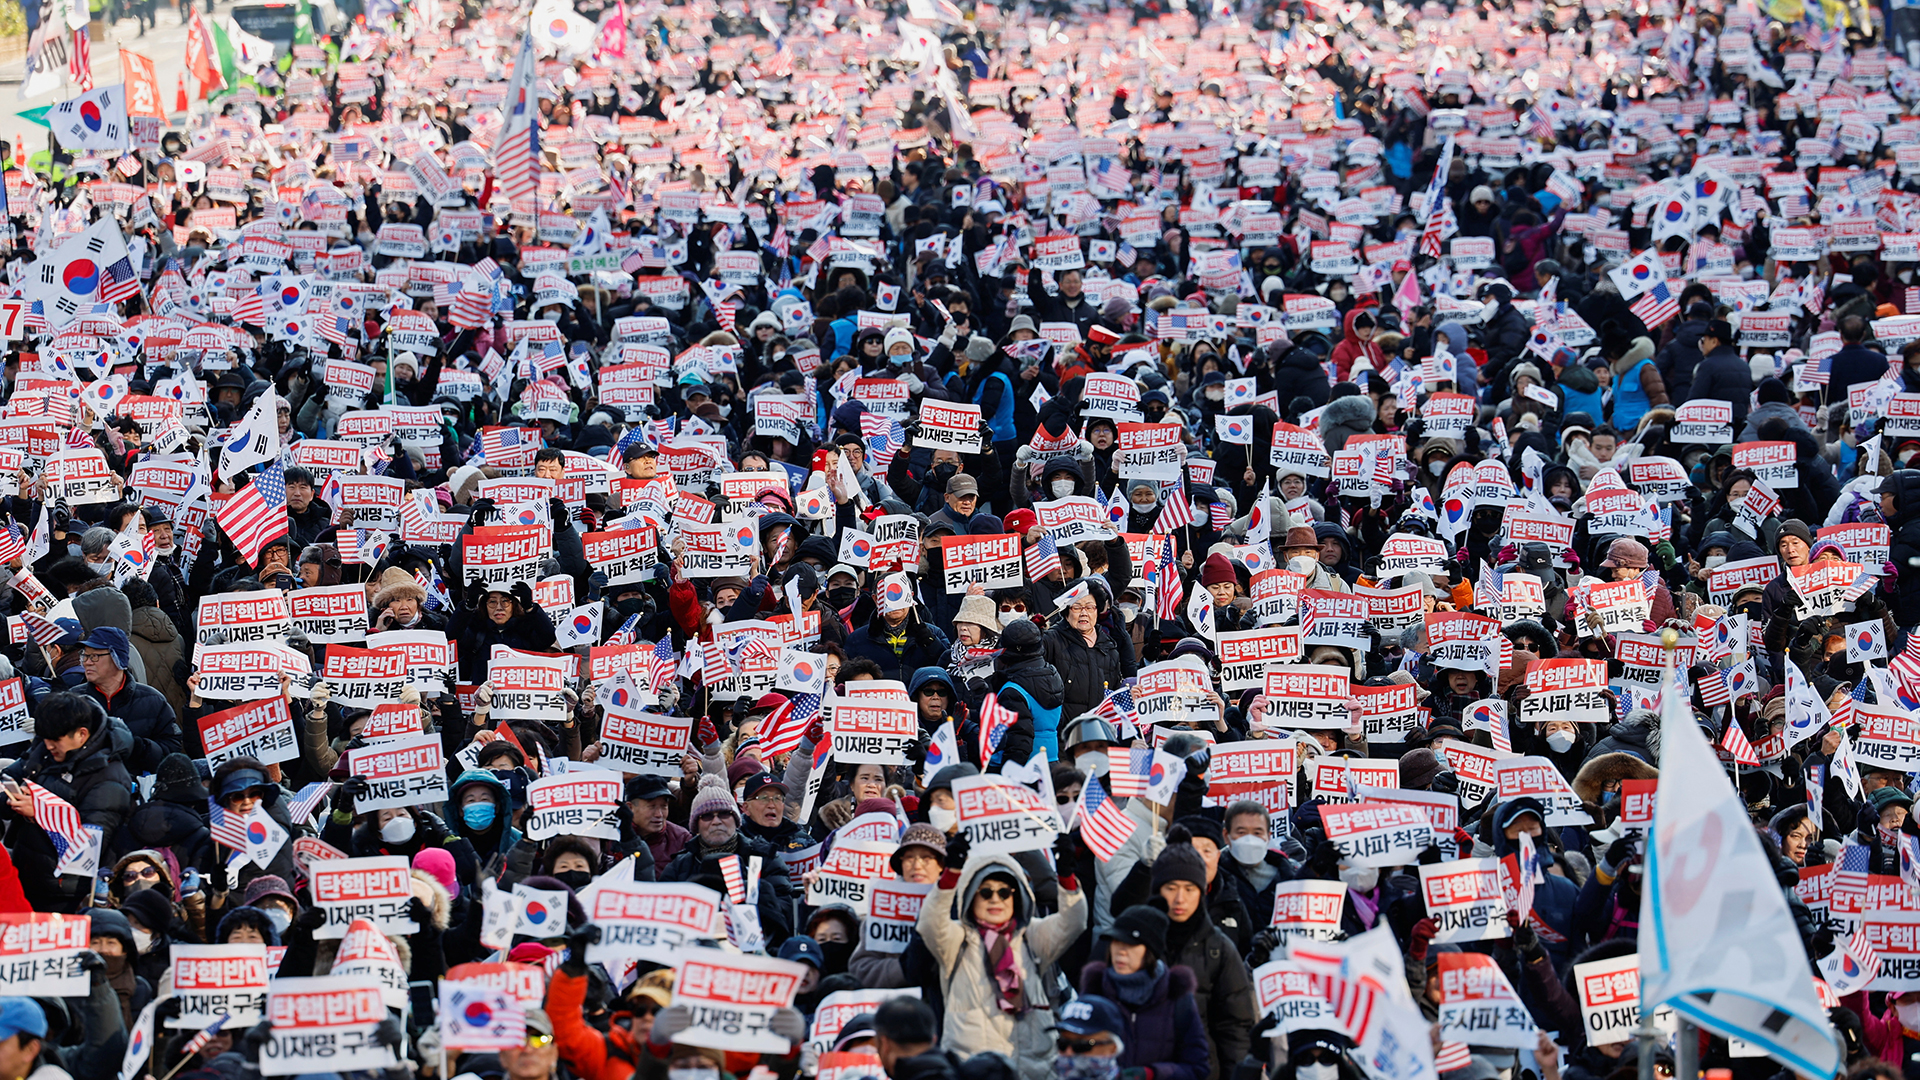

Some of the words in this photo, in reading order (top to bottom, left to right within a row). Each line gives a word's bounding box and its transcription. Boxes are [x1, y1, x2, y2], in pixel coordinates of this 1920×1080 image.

[389, 315, 437, 335] 탄핵반대
[1740, 316, 1790, 331] 탄핵반대
[326, 367, 374, 387] 탄핵반대
[601, 369, 652, 386] 탄핵반대
[459, 382, 479, 397] 척결
[601, 389, 651, 404] 탄핵반대
[856, 383, 910, 399] 탄핵반대
[1088, 379, 1140, 401] 탄핵반대
[118, 400, 180, 419] 탄핵반대
[389, 409, 440, 427] 탄핵반대
[756, 403, 801, 425] 탄핵반대
[1678, 405, 1732, 424] 탄핵반대
[340, 416, 391, 433] 탄핵반대
[756, 416, 785, 432] 이재명
[922, 410, 981, 432] 탄핵반대
[1673, 425, 1705, 439] 이재명
[1708, 422, 1731, 438] 구속
[914, 427, 953, 445] 이재명
[956, 431, 982, 448] 구속
[1121, 427, 1181, 449] 탄핵반대
[300, 446, 357, 463] 탄핵반대
[1123, 451, 1155, 468] 주사파
[1271, 450, 1303, 467] 주사파
[1734, 446, 1795, 469] 탄핵반대
[657, 455, 716, 477] 탄핵반대
[1769, 463, 1796, 481] 척결
[89, 480, 118, 497] 구속
[344, 484, 400, 502] 탄핵반대
[1047, 523, 1085, 540] 이재명
[1511, 521, 1568, 542] 탄핵반대
[466, 538, 534, 562] 탄핵반대
[589, 529, 656, 556] 탄핵반대
[945, 537, 1019, 566] 탄핵반대
[1381, 539, 1444, 556] 탄핵반대
[629, 554, 657, 576] 척결
[682, 554, 723, 570] 이재명
[1379, 559, 1418, 574] 이재명
[1862, 552, 1886, 567] 척결
[466, 566, 508, 584] 주사파
[511, 564, 539, 582] 척결
[989, 564, 1020, 583] 척결
[1713, 570, 1779, 591] 탄핵반대
[223, 600, 288, 620] 탄핵반대
[294, 595, 363, 616] 탄핵반대
[1621, 607, 1645, 625] 척결
[296, 619, 336, 637] 이재명
[339, 617, 367, 634] 구속
[1342, 620, 1368, 638] 척결
[1428, 620, 1499, 647] 탄핵반대
[1222, 637, 1298, 660] 탄핵반대
[204, 654, 279, 674] 탄핵반대
[326, 655, 404, 677] 탄핵반대
[200, 676, 245, 692] 이재명
[248, 676, 279, 691] 구속
[493, 670, 562, 689] 탄핵반대
[1526, 661, 1604, 689] 탄핵반대
[327, 682, 371, 699] 주사파
[1268, 676, 1346, 697] 탄핵반대
[493, 694, 531, 711] 이재명
[534, 694, 564, 711] 구속
[1267, 700, 1312, 719] 이재명
[1315, 700, 1348, 718] 구속
[1523, 693, 1572, 716] 주사파
[1577, 690, 1609, 712] 척결
[204, 697, 287, 754] 탄핵반대
[608, 717, 685, 747] 탄핵반대
[838, 711, 911, 732] 탄핵반대
[1387, 714, 1416, 734] 척결
[260, 726, 294, 757] 척결
[835, 735, 882, 755] 이재명
[1851, 740, 1896, 761] 이재명
[357, 744, 438, 775] 탄핵반대
[601, 742, 648, 766] 이재명
[1211, 752, 1293, 779] 탄핵반대
[409, 774, 444, 797] 구속
[532, 782, 618, 808] 탄핵반대
[531, 807, 583, 830] 이재명
[1327, 812, 1430, 836] 탄핵반대
[964, 818, 1020, 843] 이재명
[1393, 829, 1431, 852] 척결
[318, 872, 410, 899] 탄핵반대
[813, 875, 864, 901] 이재명
[1428, 873, 1500, 904] 탄핵반대
[598, 893, 714, 930] 탄핵반대
[873, 892, 919, 918] 탄핵
[1278, 895, 1340, 921] 탄핵반대
[1437, 905, 1488, 931] 이재명
[0, 921, 87, 951] 핵반대
[684, 963, 794, 1004] 탄핵반대
[1587, 971, 1640, 1003] 탄핵
[273, 992, 381, 1025] 탄핵반대
[266, 1034, 336, 1058] 이재명
